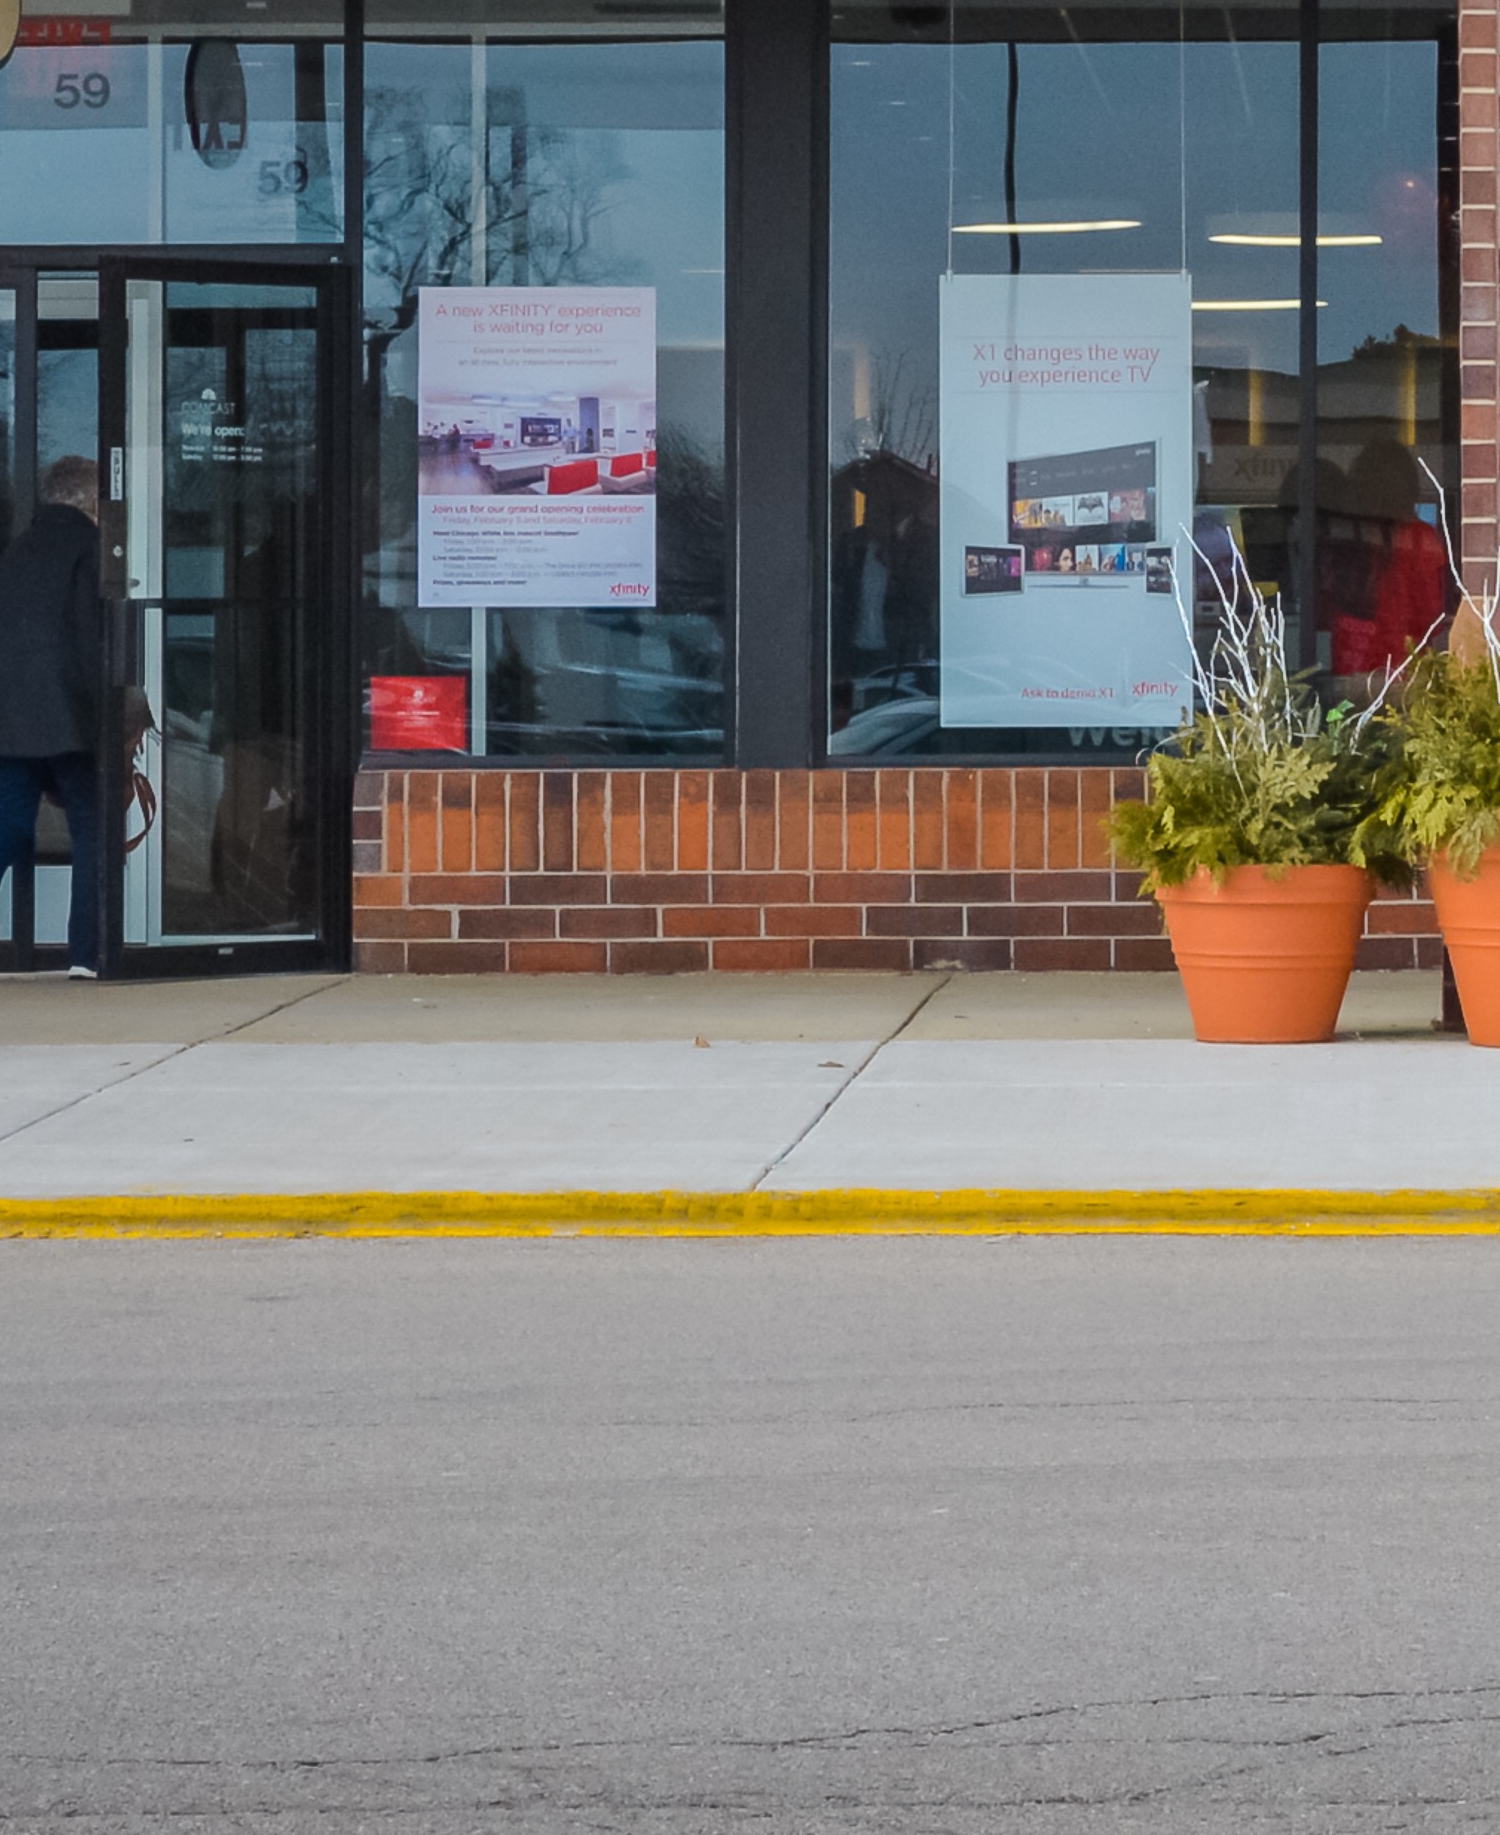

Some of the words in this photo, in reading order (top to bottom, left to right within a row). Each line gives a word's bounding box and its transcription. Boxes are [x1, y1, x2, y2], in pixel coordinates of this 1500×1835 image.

[53, 72, 111, 110] 59
[435, 304, 448, 317] A
[452, 306, 483, 317] new
[557, 304, 642, 320] experience
[473, 320, 485, 333] is
[489, 320, 545, 336] waiting
[549, 320, 571, 333] for
[575, 322, 604, 336] you
[973, 344, 996, 361] X1
[1004, 344, 1083, 364] changes
[1088, 344, 1118, 361] the
[1123, 348, 1160, 364] way
[979, 369, 1012, 387] you
[1018, 367, 1121, 386] experience
[1126, 366, 1152, 382] TV
[431, 504, 453, 514] Join
[455, 504, 468, 514] us
[469, 504, 485, 514] for
[487, 504, 505, 514] our
[507, 504, 538, 514] grand
[540, 504, 584, 514] opening
[586, 504, 645, 514] celebration
[610, 582, 649, 596] xfinity
[1021, 687, 1042, 698] Ask
[1046, 688, 1058, 698] to
[1061, 687, 1095, 698] demo
[1099, 687, 1115, 698] X1
[1132, 681, 1178, 697] xfinity
